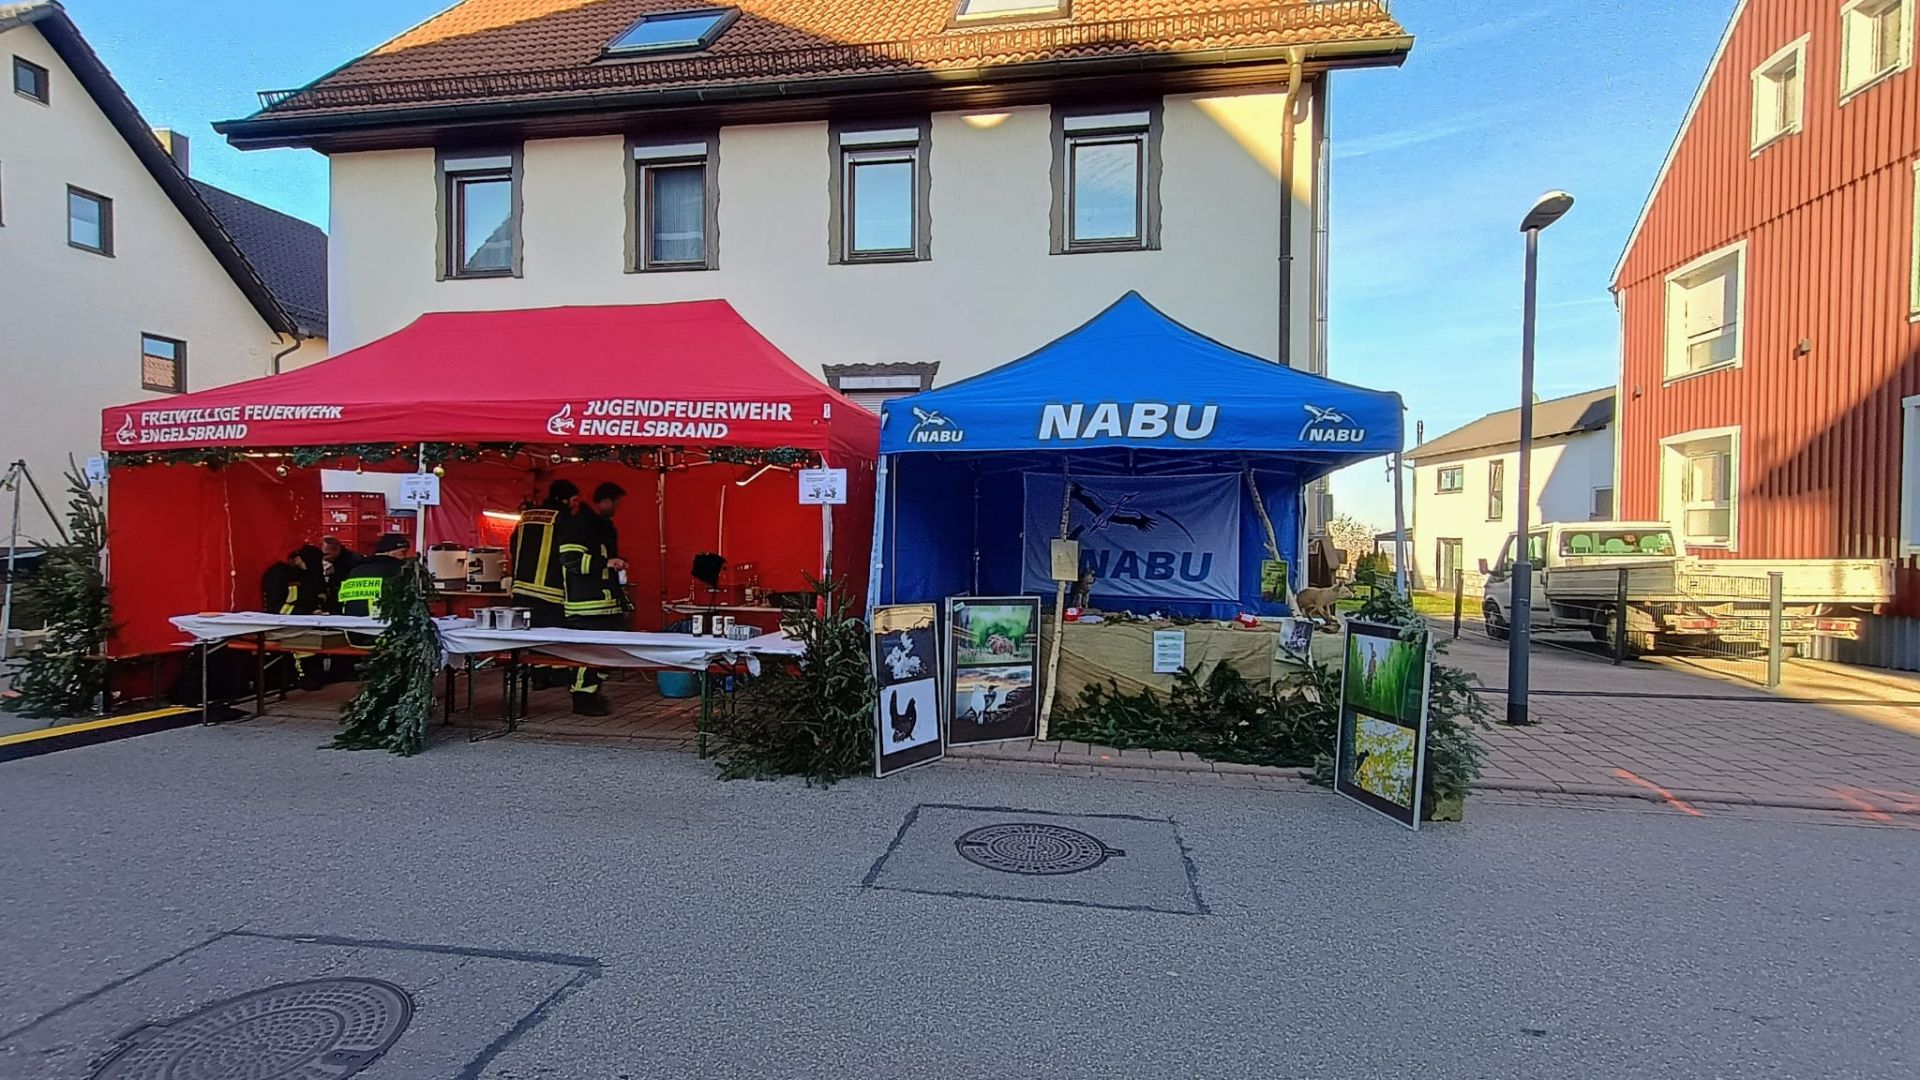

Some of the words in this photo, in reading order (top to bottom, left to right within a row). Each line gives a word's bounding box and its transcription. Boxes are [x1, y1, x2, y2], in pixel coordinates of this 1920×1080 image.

[141, 407, 240, 426] FREIWILLIGE
[244, 405, 343, 420] FEUERWEHR
[583, 399, 792, 421] JUGENDFEUERWEHR
[579, 419, 728, 439] ENGELSBRAND
[1038, 402, 1219, 441] NABU
[140, 424, 248, 444] ENGELSBRAND
[916, 430, 964, 443] NABU
[1309, 428, 1365, 442] NABU
[1080, 549, 1213, 582] NABU
